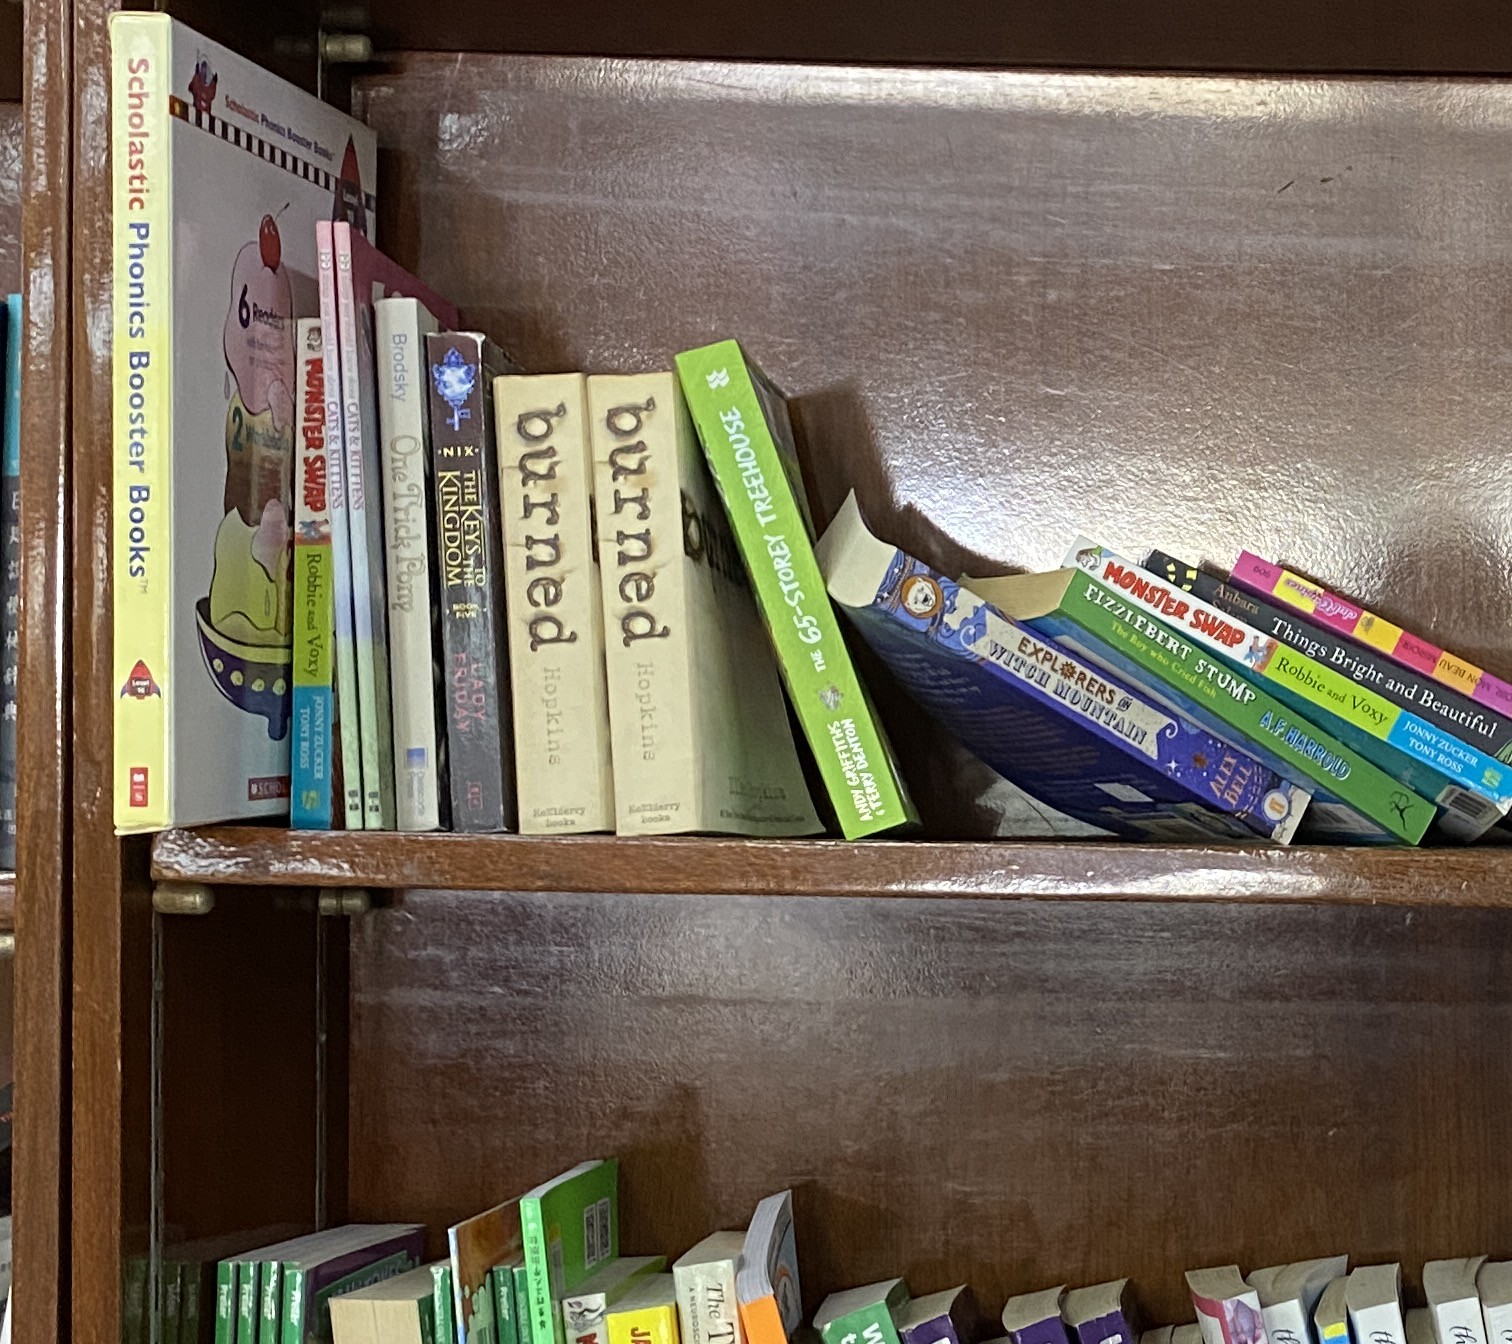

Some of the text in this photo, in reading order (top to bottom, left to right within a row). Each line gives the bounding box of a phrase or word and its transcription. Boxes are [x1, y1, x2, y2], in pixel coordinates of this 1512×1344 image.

[126, 57, 151, 210] Scholastic
[128, 221, 152, 340] Phonics
[126, 351, 150, 465] Booster
[304, 357, 327, 515] MONSTER SWAP
[438, 470, 461, 589] KINGDOM
[517, 401, 578, 652] burned
[606, 397, 671, 648] burned
[719, 406, 827, 672] THE 65-STOREY TREEHOUSE
[1082, 582, 1257, 706] FIZZLEBERT STUMP
[1102, 561, 1246, 650] MONSTER SWAP
[541, 666, 561, 765] Hopkins
[987, 639, 1147, 747] WITCH MOUNTAIN
[1269, 615, 1499, 740] Things Bright and Beautiful
[1276, 656, 1390, 727] Robbie and Voxy
[1402, 719, 1479, 768] JONNY ZUCKER
[1408, 735, 1464, 774] TONY ROSS
[705, 1281, 724, 1321] The
